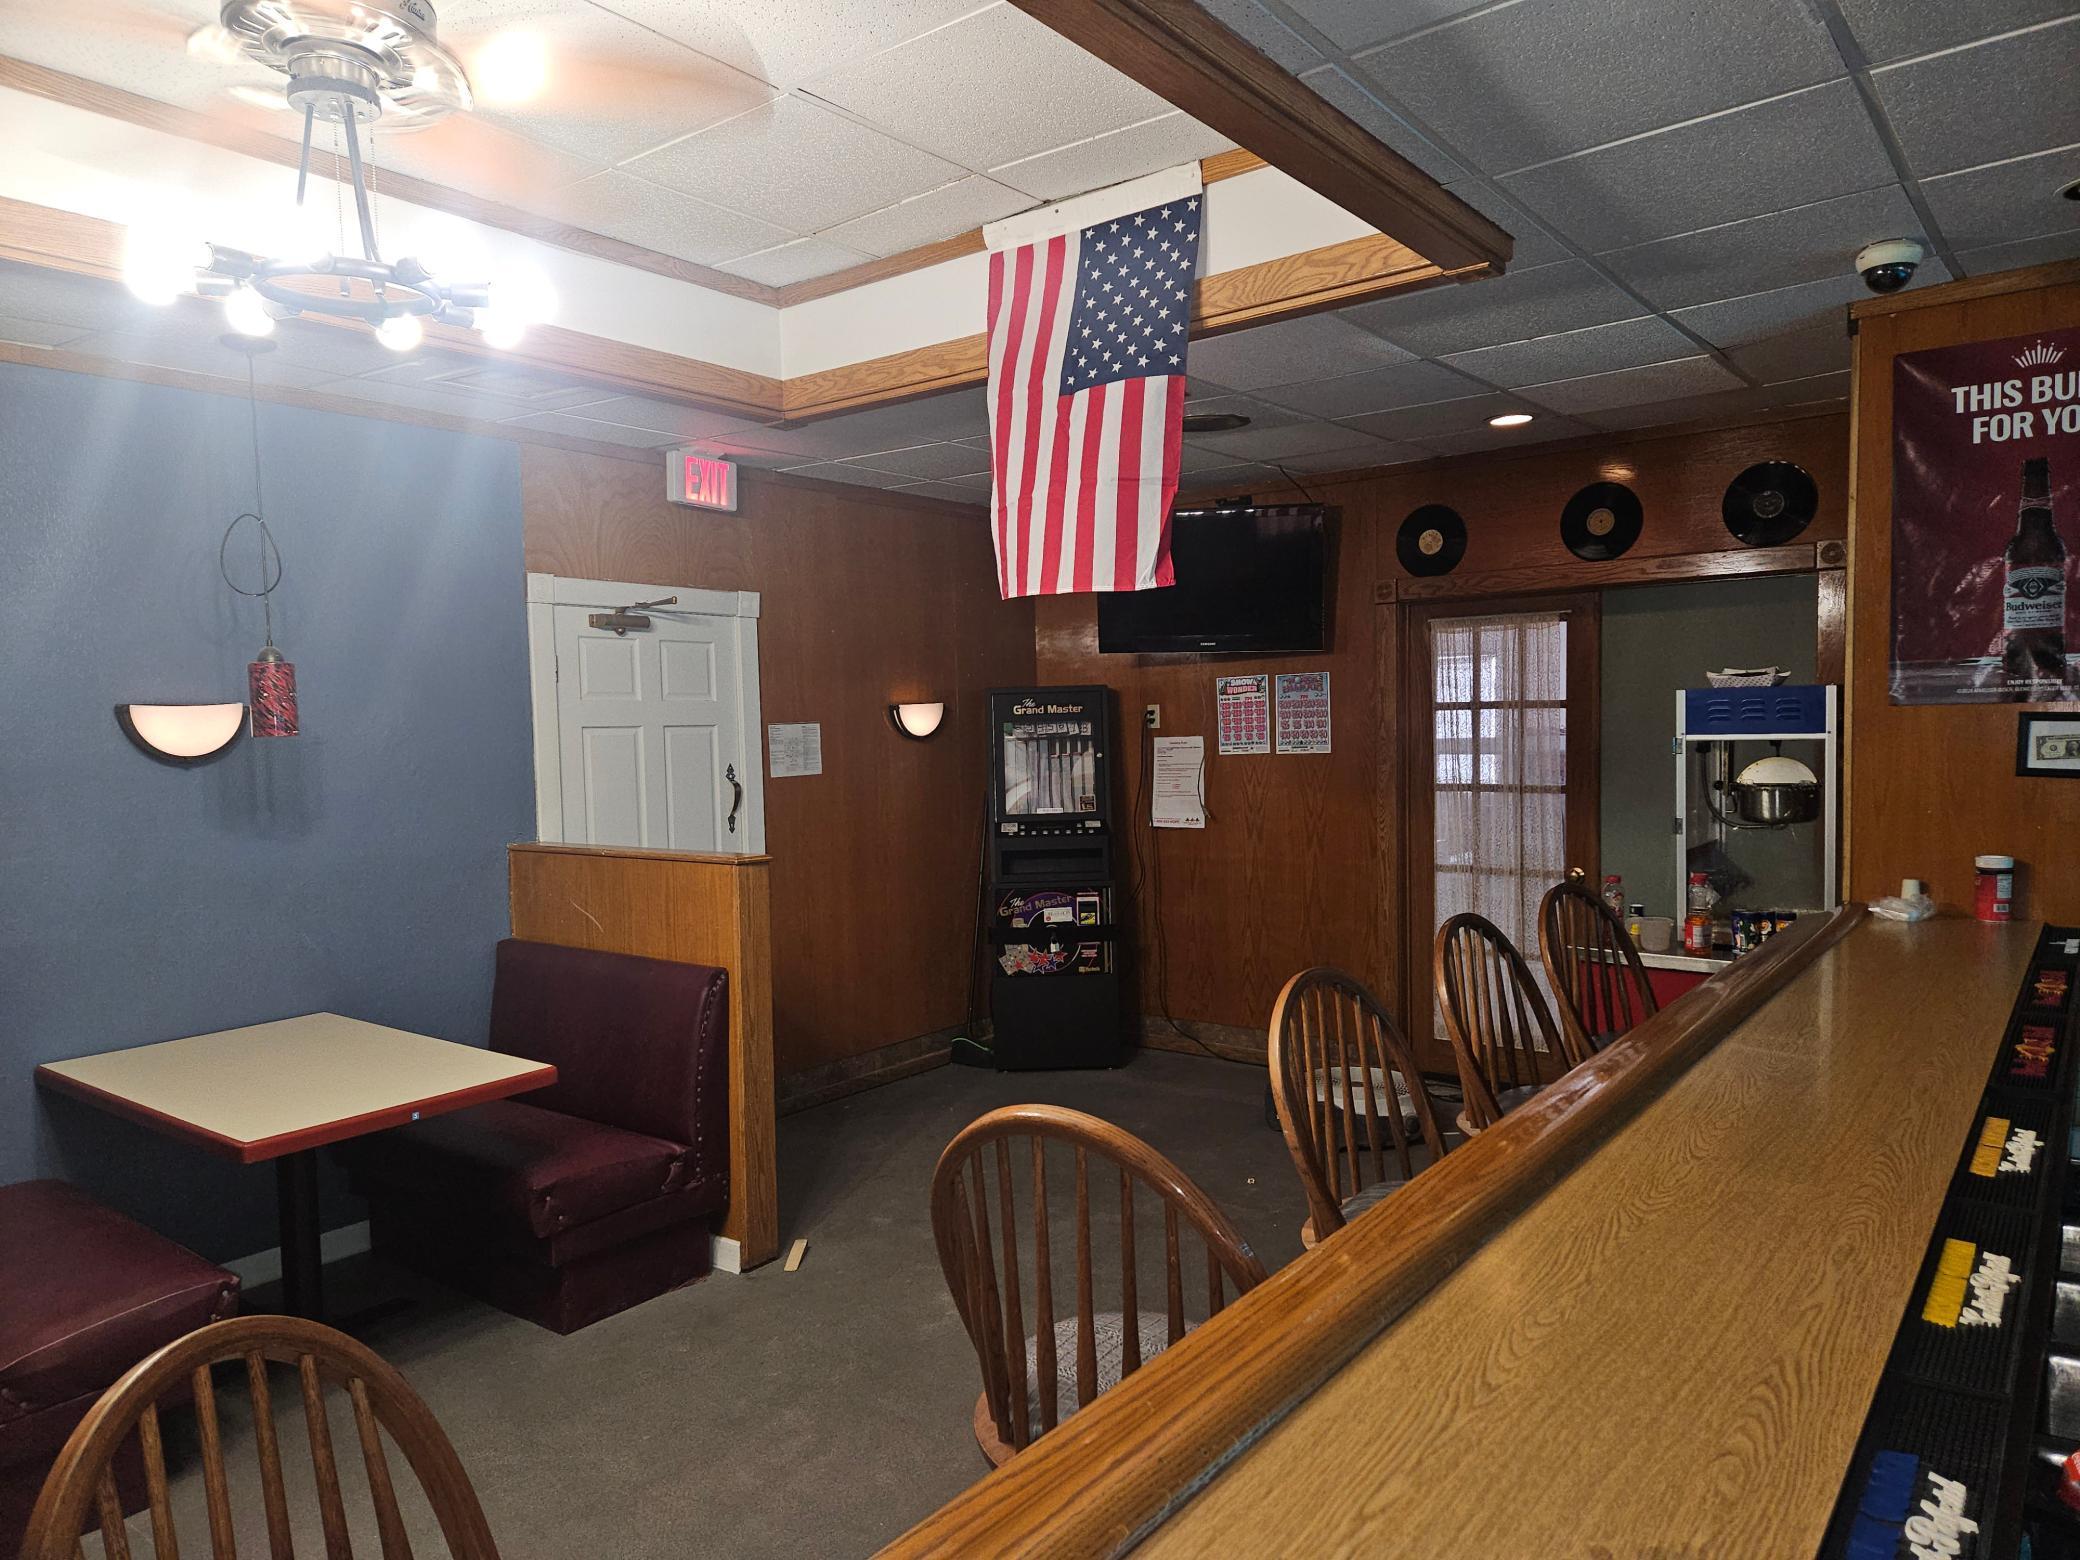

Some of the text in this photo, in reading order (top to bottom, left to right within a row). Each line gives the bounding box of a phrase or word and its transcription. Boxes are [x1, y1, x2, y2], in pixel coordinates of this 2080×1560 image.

[1951, 370, 2080, 414] THIS BU
[1972, 404, 2080, 444] FOR YO
[685, 455, 730, 506] EXIT
[2005, 600, 2063, 612] Budweiser
[1226, 685, 1257, 695] WONDER
[1021, 698, 1036, 707] The
[1013, 704, 1083, 715] Grand Master
[1000, 902, 1032, 917] Grand
[1035, 894, 1072, 908] Master
[1009, 897, 1025, 908] The
